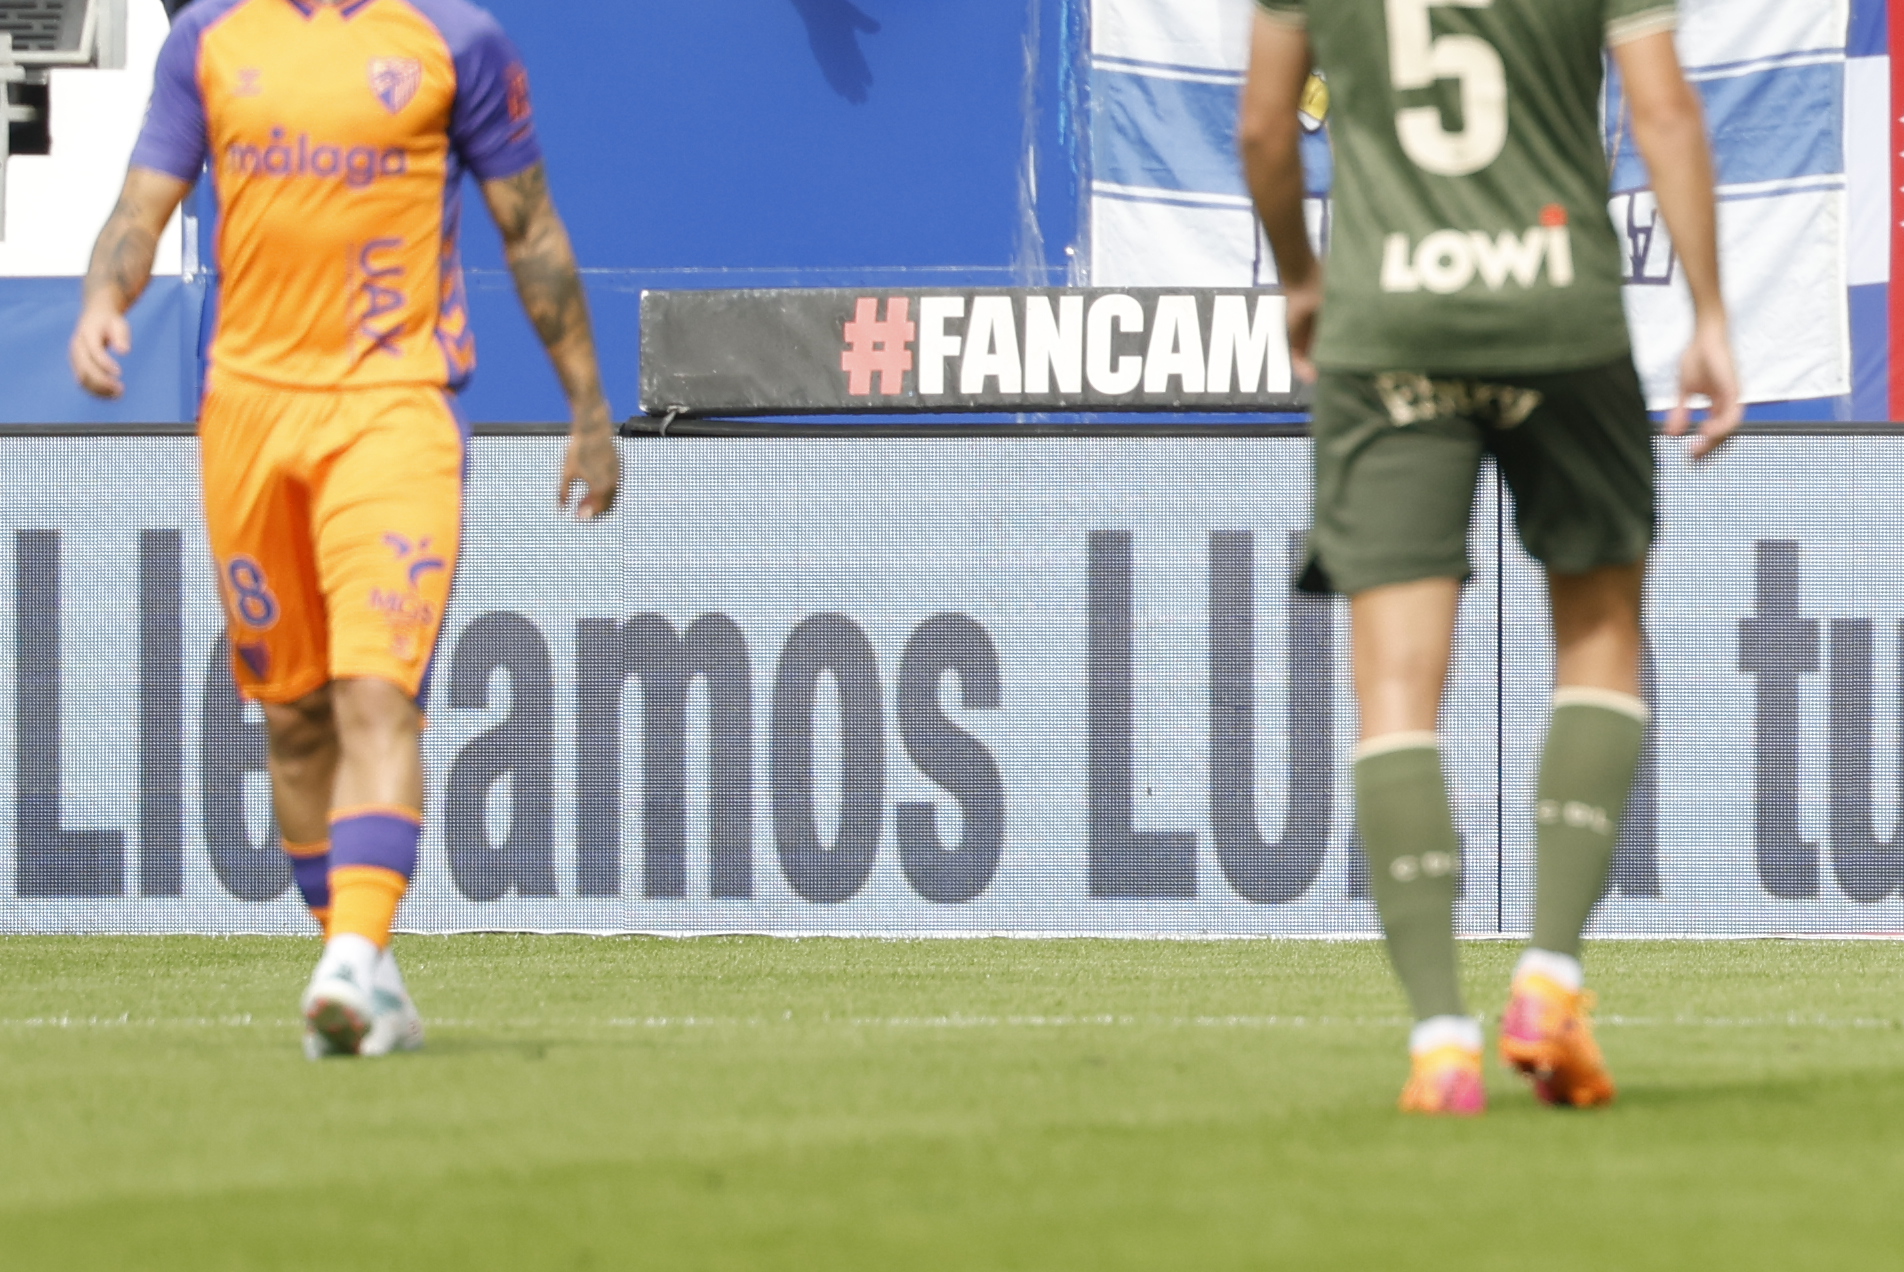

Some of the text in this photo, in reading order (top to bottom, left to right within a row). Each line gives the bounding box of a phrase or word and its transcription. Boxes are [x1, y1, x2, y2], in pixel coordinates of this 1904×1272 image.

[841, 294, 1292, 396] #FANCAM
[16, 529, 1005, 904] Lleamos
[1087, 529, 1465, 905] LU
